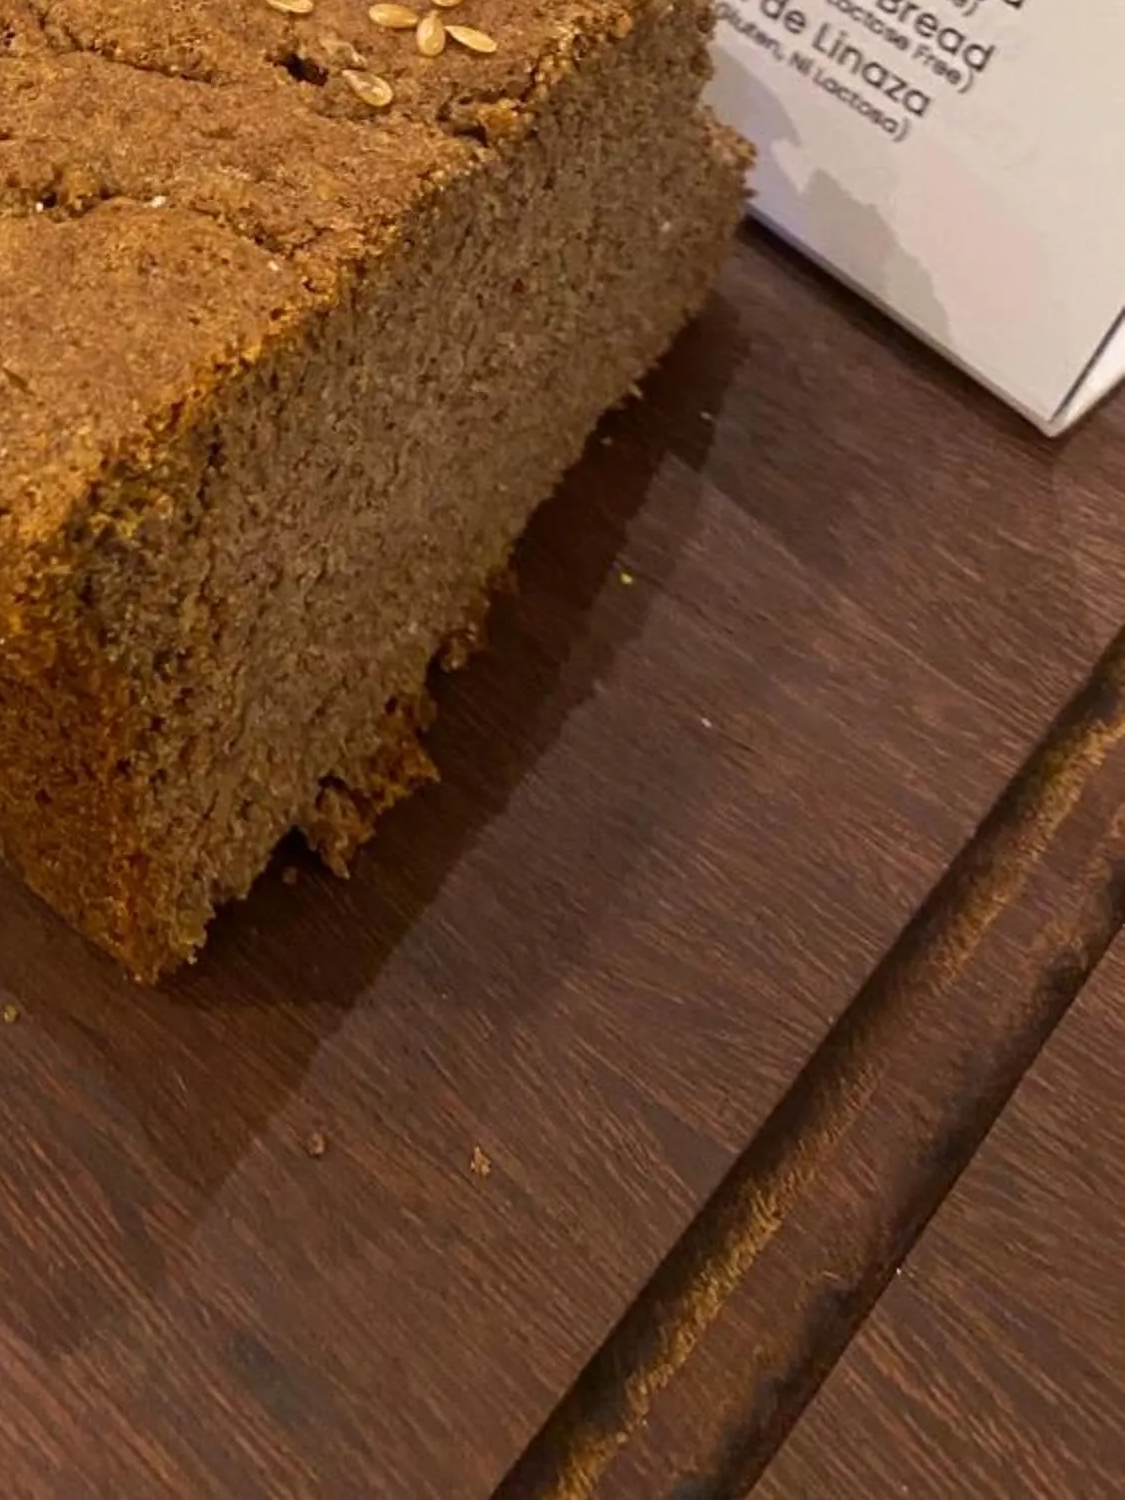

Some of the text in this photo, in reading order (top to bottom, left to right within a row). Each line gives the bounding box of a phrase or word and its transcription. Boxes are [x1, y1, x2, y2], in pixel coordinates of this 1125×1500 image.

[812, 22, 931, 117] Linaza
[812, 68, 911, 142] Lactosa)
[912, 43, 974, 94] Free)
